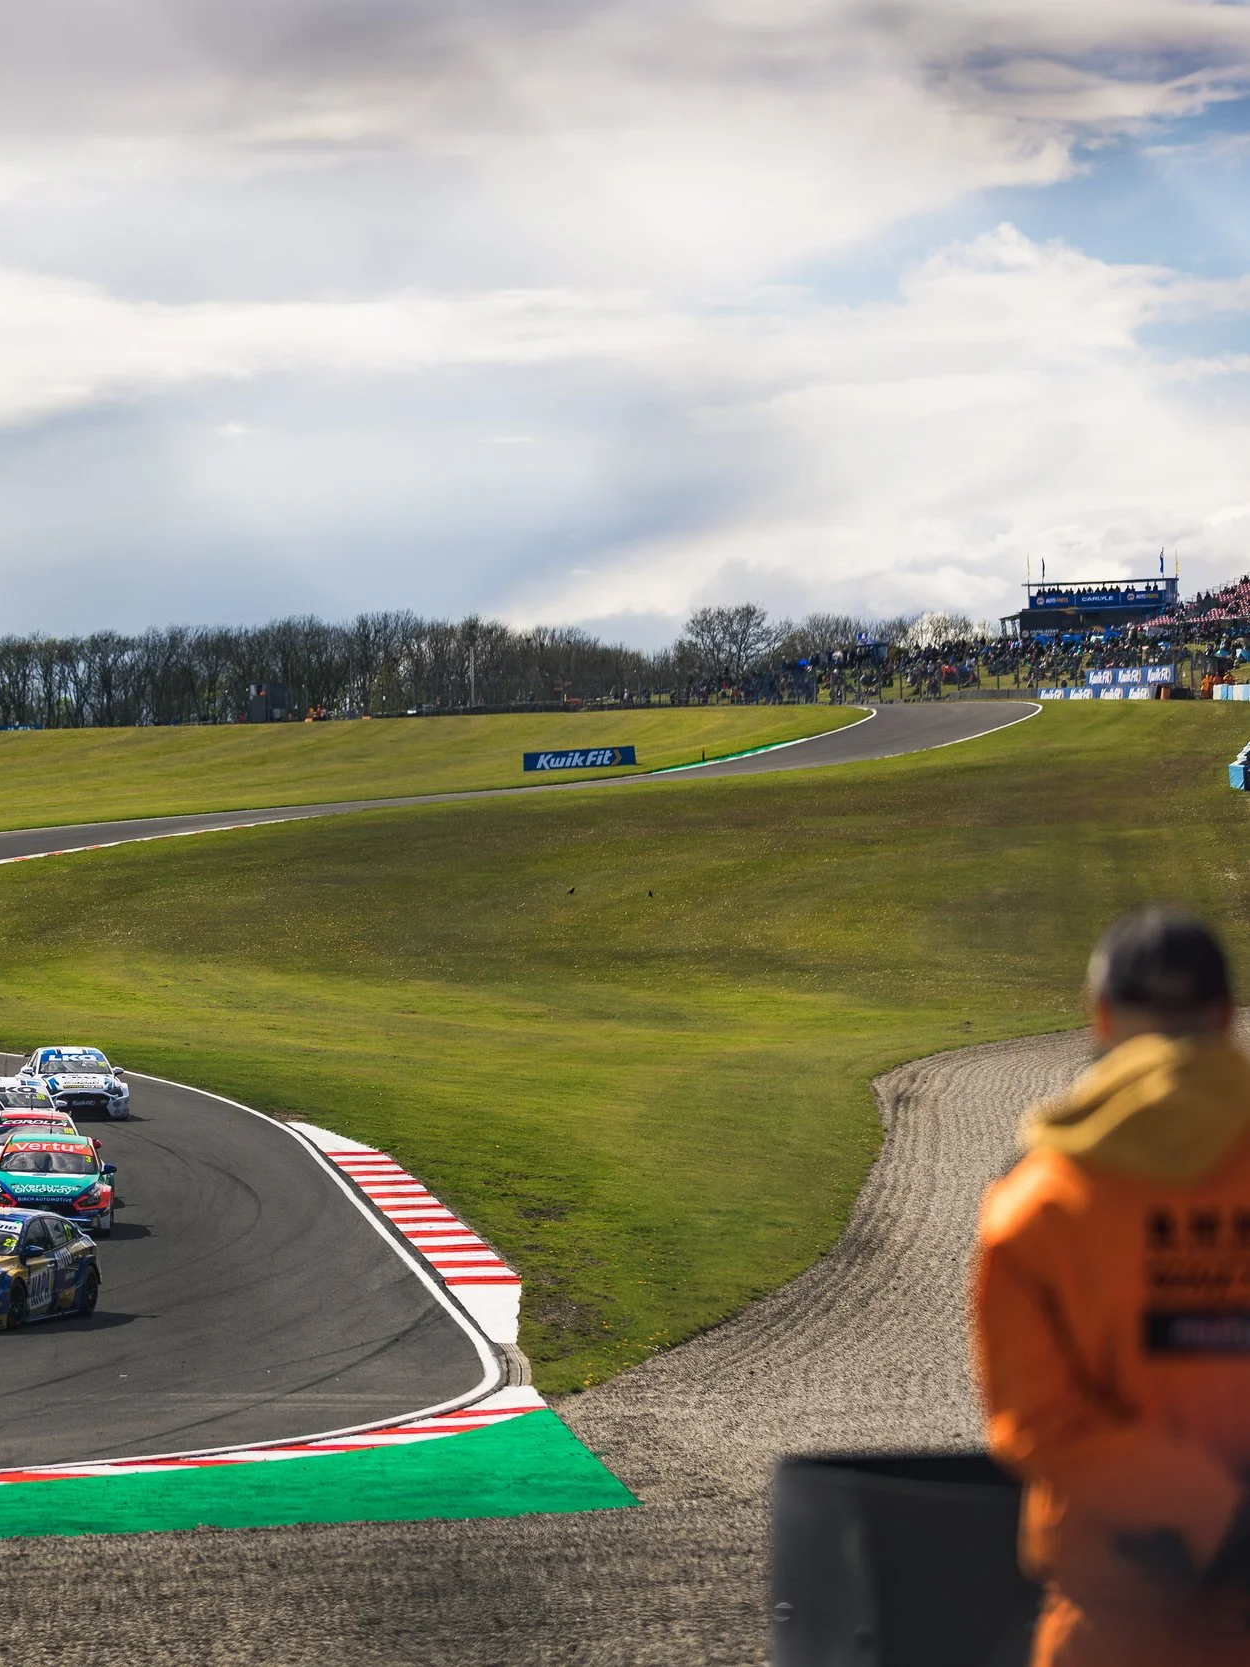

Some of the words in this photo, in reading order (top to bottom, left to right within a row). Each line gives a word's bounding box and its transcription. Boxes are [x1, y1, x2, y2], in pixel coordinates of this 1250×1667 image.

[48, 1054, 97, 1062] LKQ
[2, 1119, 68, 1127] COROLLA
[85, 1155, 92, 1163] 3
